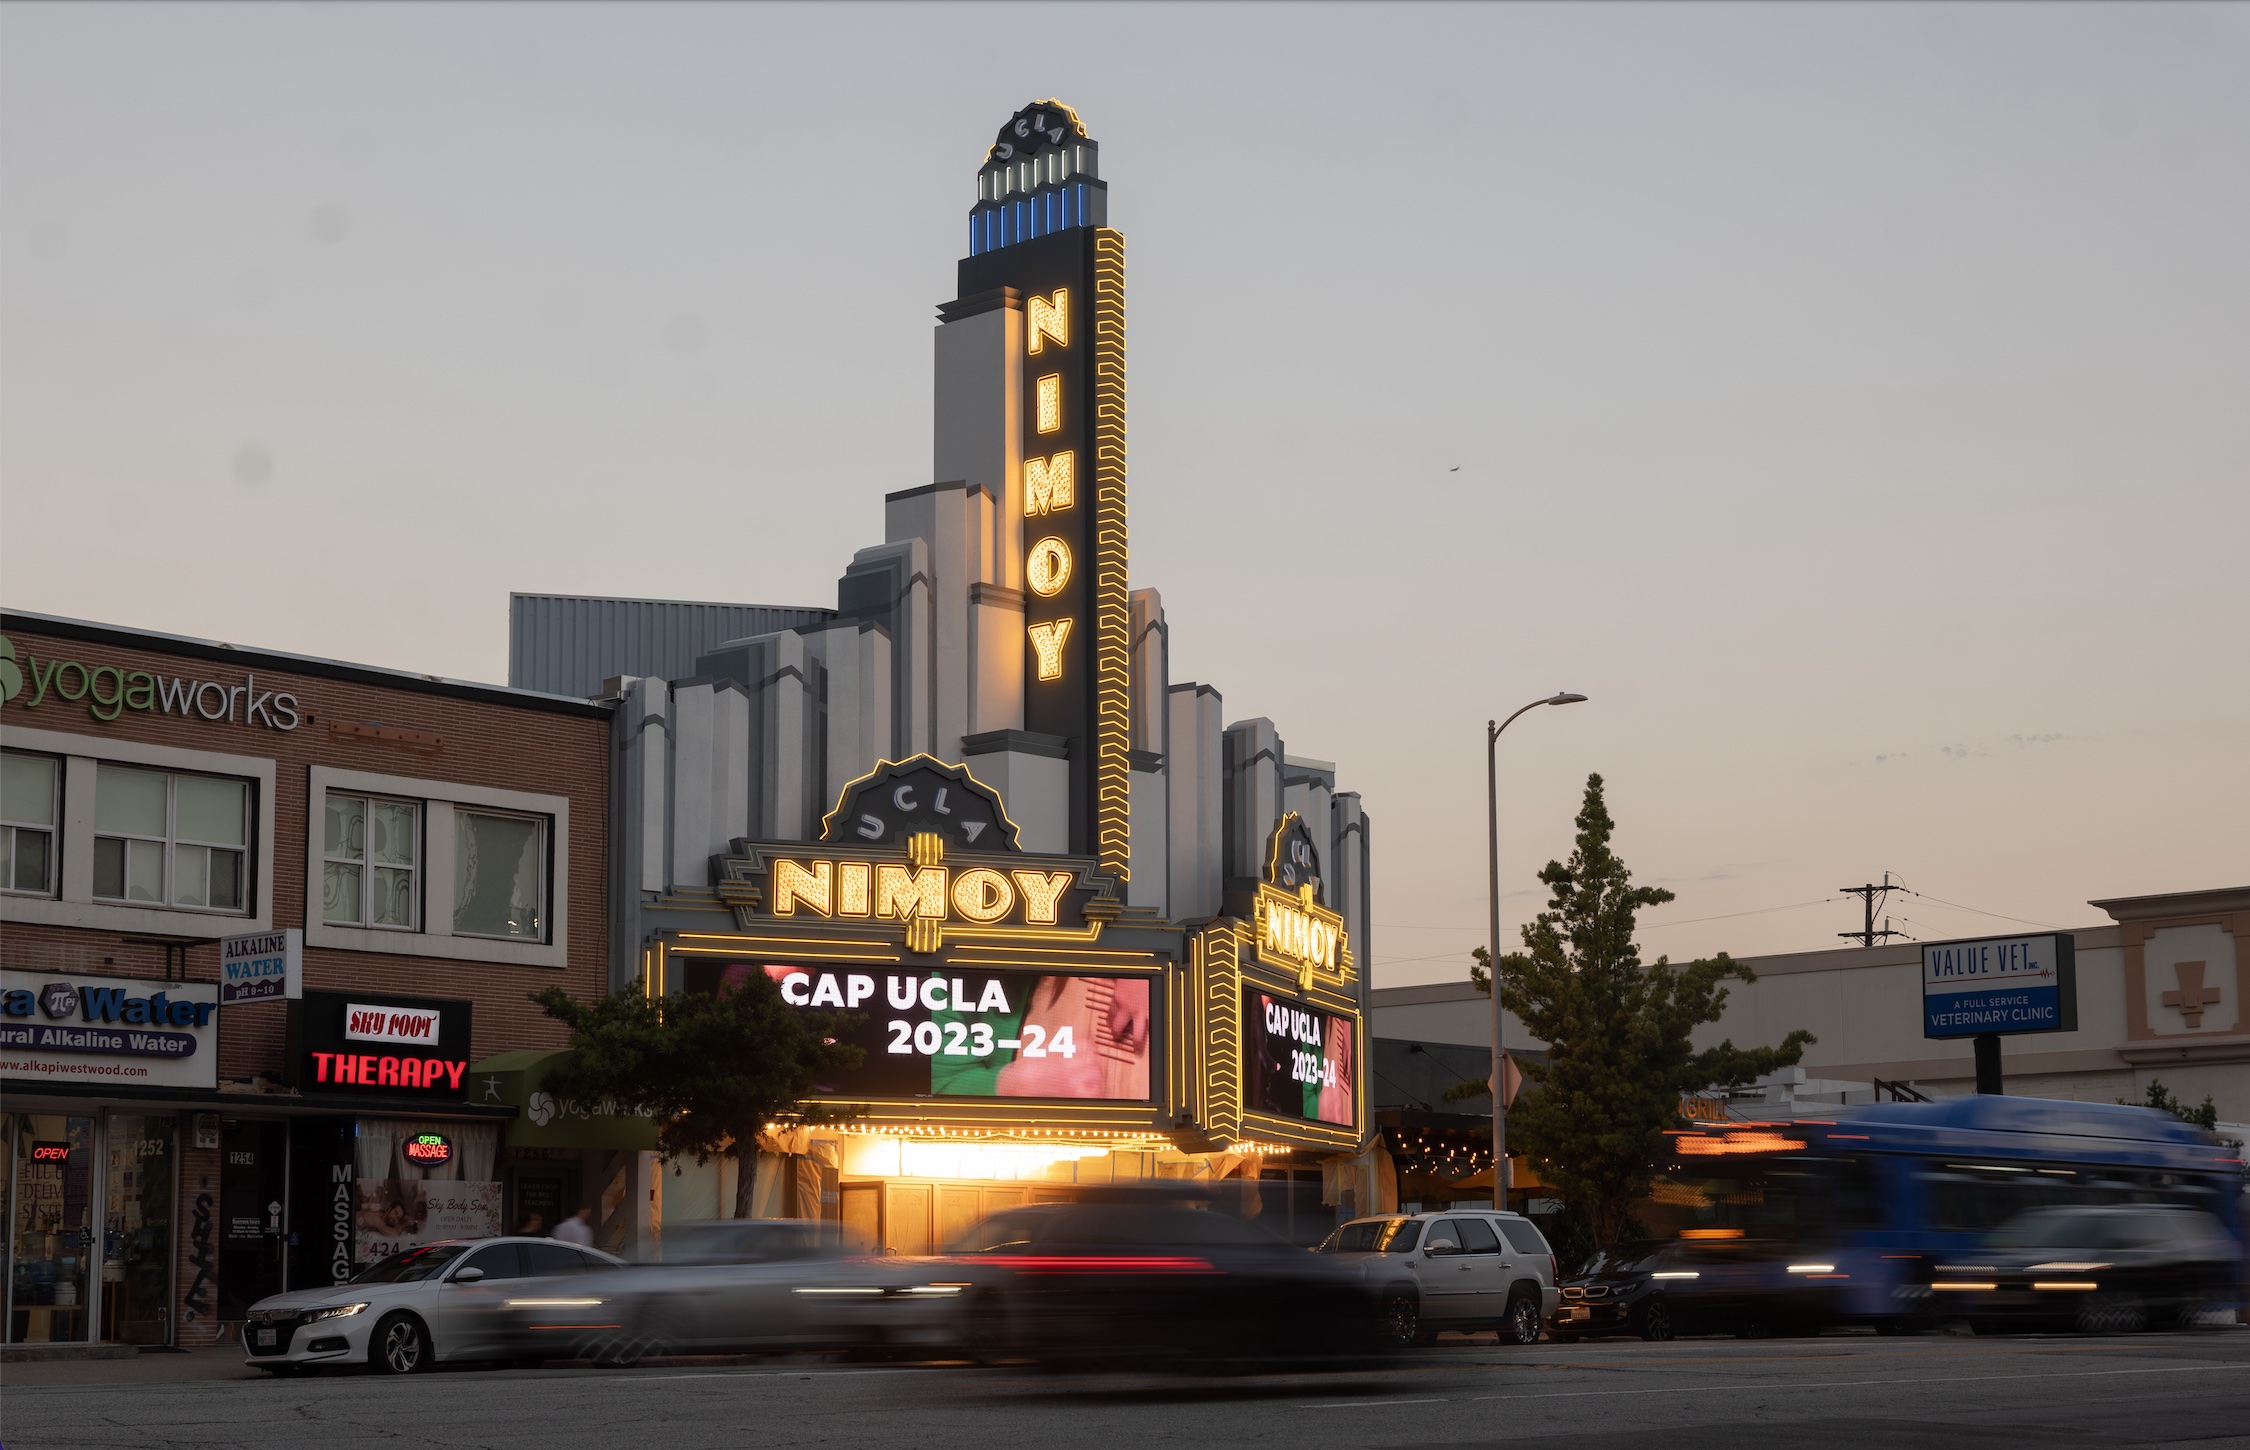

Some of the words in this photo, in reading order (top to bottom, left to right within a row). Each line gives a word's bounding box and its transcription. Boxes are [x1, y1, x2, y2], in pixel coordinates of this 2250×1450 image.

[996, 113, 1066, 159] UCLA
[1023, 287, 1075, 682] NIMOY
[24, 655, 299, 731] yogaworks
[857, 785, 988, 844] UCLA
[773, 858, 1073, 925] NIMOY
[225, 934, 286, 958] ALKALINE
[1266, 898, 1338, 971] NIMOY
[225, 957, 285, 980] WATER
[1932, 946, 1989, 977] VALUE
[1997, 943, 2029, 972] VET
[235, 986, 249, 1000] pH
[780, 972, 875, 1009] CAP
[886, 975, 1012, 1014] UCLA
[1953, 1000, 1961, 1009] A
[1963, 998, 1986, 1009] FULL
[1989, 996, 2029, 1007] SERVICE
[78, 986, 217, 1027] Water
[1931, 1009, 2009, 1027] VETERINARY
[2011, 1006, 2054, 1021] CLINIC
[1265, 1002, 1290, 1037] CAP
[1290, 1009, 1321, 1047] UCLA
[40, 1028, 123, 1049] Alkaline
[129, 1033, 188, 1053] Water
[311, 1051, 468, 1090] THERAPY
[1684, 1096, 1731, 1120] GRILL
[132, 1138, 164, 1156] 1252
[408, 1144, 449, 1158] MASSAGE
[418, 1134, 442, 1146] OPEN
[33, 1147, 70, 1160] OPEN
[231, 1151, 253, 1165] 1254
[515, 1146, 549, 1161] 1256
[426, 1198, 444, 1213] Sky
[447, 1198, 468, 1214] Body
[470, 1199, 488, 1214] Spa
[331, 1164, 352, 1287] MASSAG
